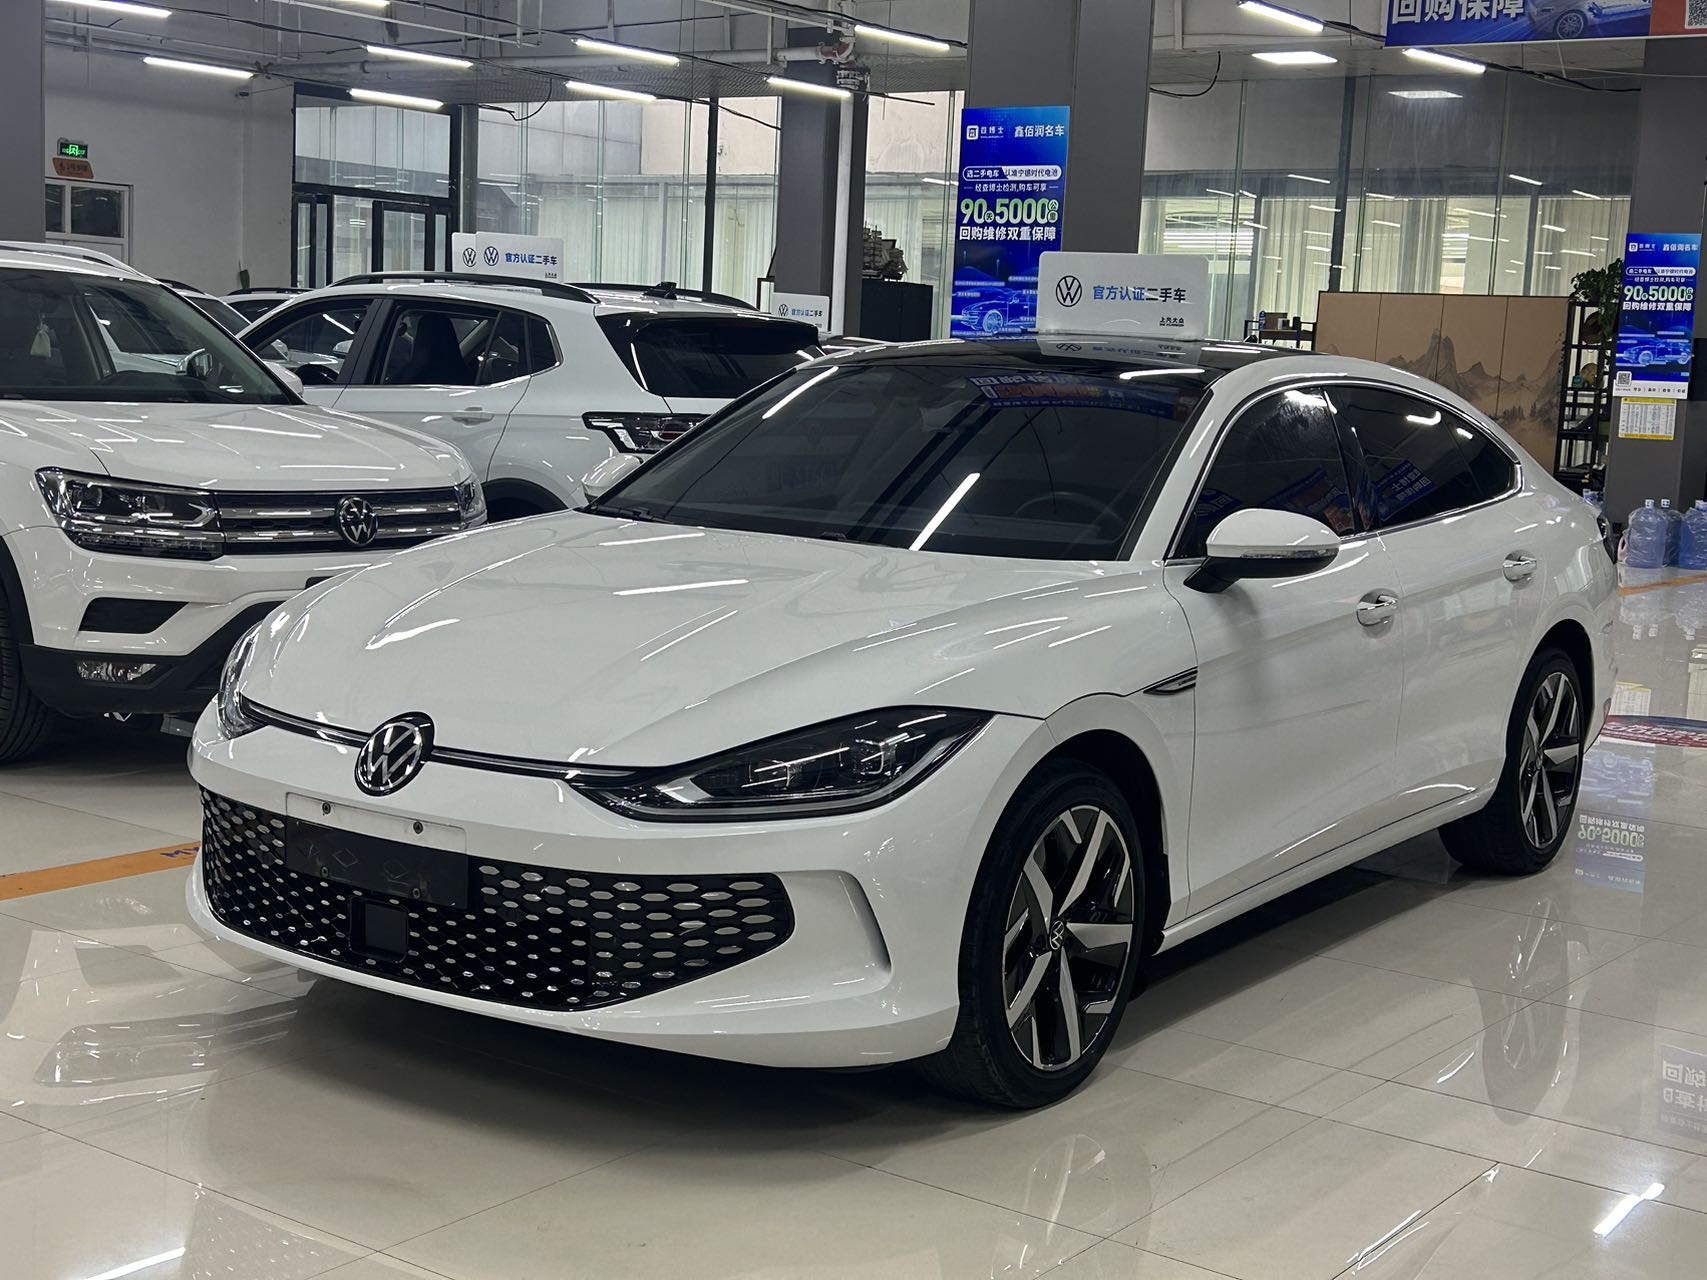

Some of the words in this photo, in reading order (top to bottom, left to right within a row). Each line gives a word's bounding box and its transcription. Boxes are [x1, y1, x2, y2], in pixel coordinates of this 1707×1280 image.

[1392, 0, 1525, 24] 回购保障
[1014, 125, 1065, 138] 鑫佰润名车
[960, 226, 1057, 241] 回购维修双重保障
[505, 253, 558, 265] 官方认证二手车
[1092, 285, 1187, 303] 官方认证二手车
